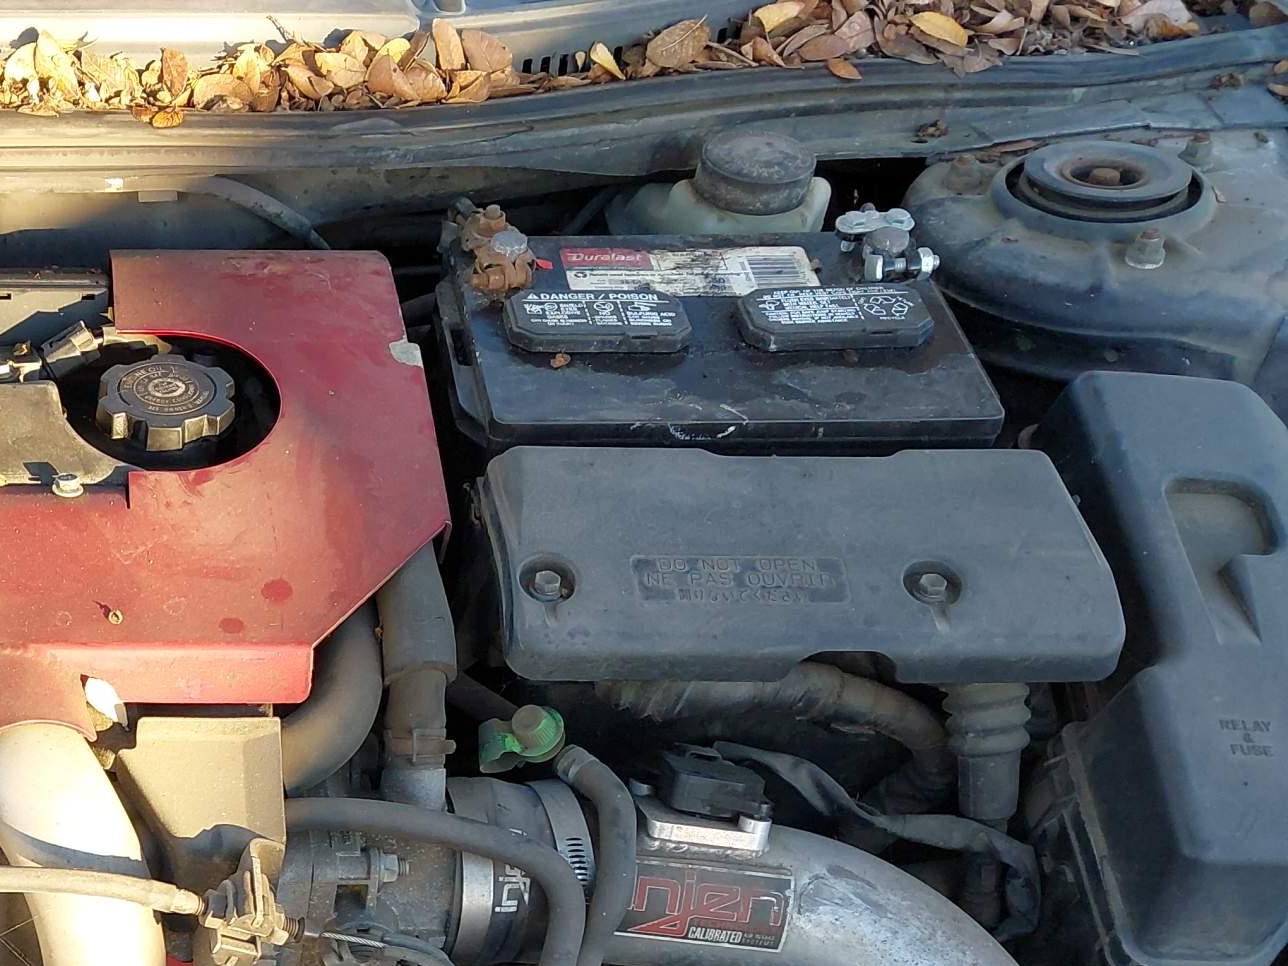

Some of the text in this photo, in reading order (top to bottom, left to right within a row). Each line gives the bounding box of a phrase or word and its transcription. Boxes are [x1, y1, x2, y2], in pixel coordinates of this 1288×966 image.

[569, 252, 643, 263] Duralast
[540, 292, 594, 301] DANGER
[608, 293, 658, 302] POISON
[657, 559, 816, 571] DO NOT OPEN
[646, 573, 675, 586] NE
[688, 573, 734, 586] PAS
[1218, 719, 1272, 732] RELAY
[1242, 732, 1256, 743] &
[1230, 743, 1273, 757] FUSE
[630, 871, 785, 937] njen
[688, 926, 743, 944] CALIBRATED
